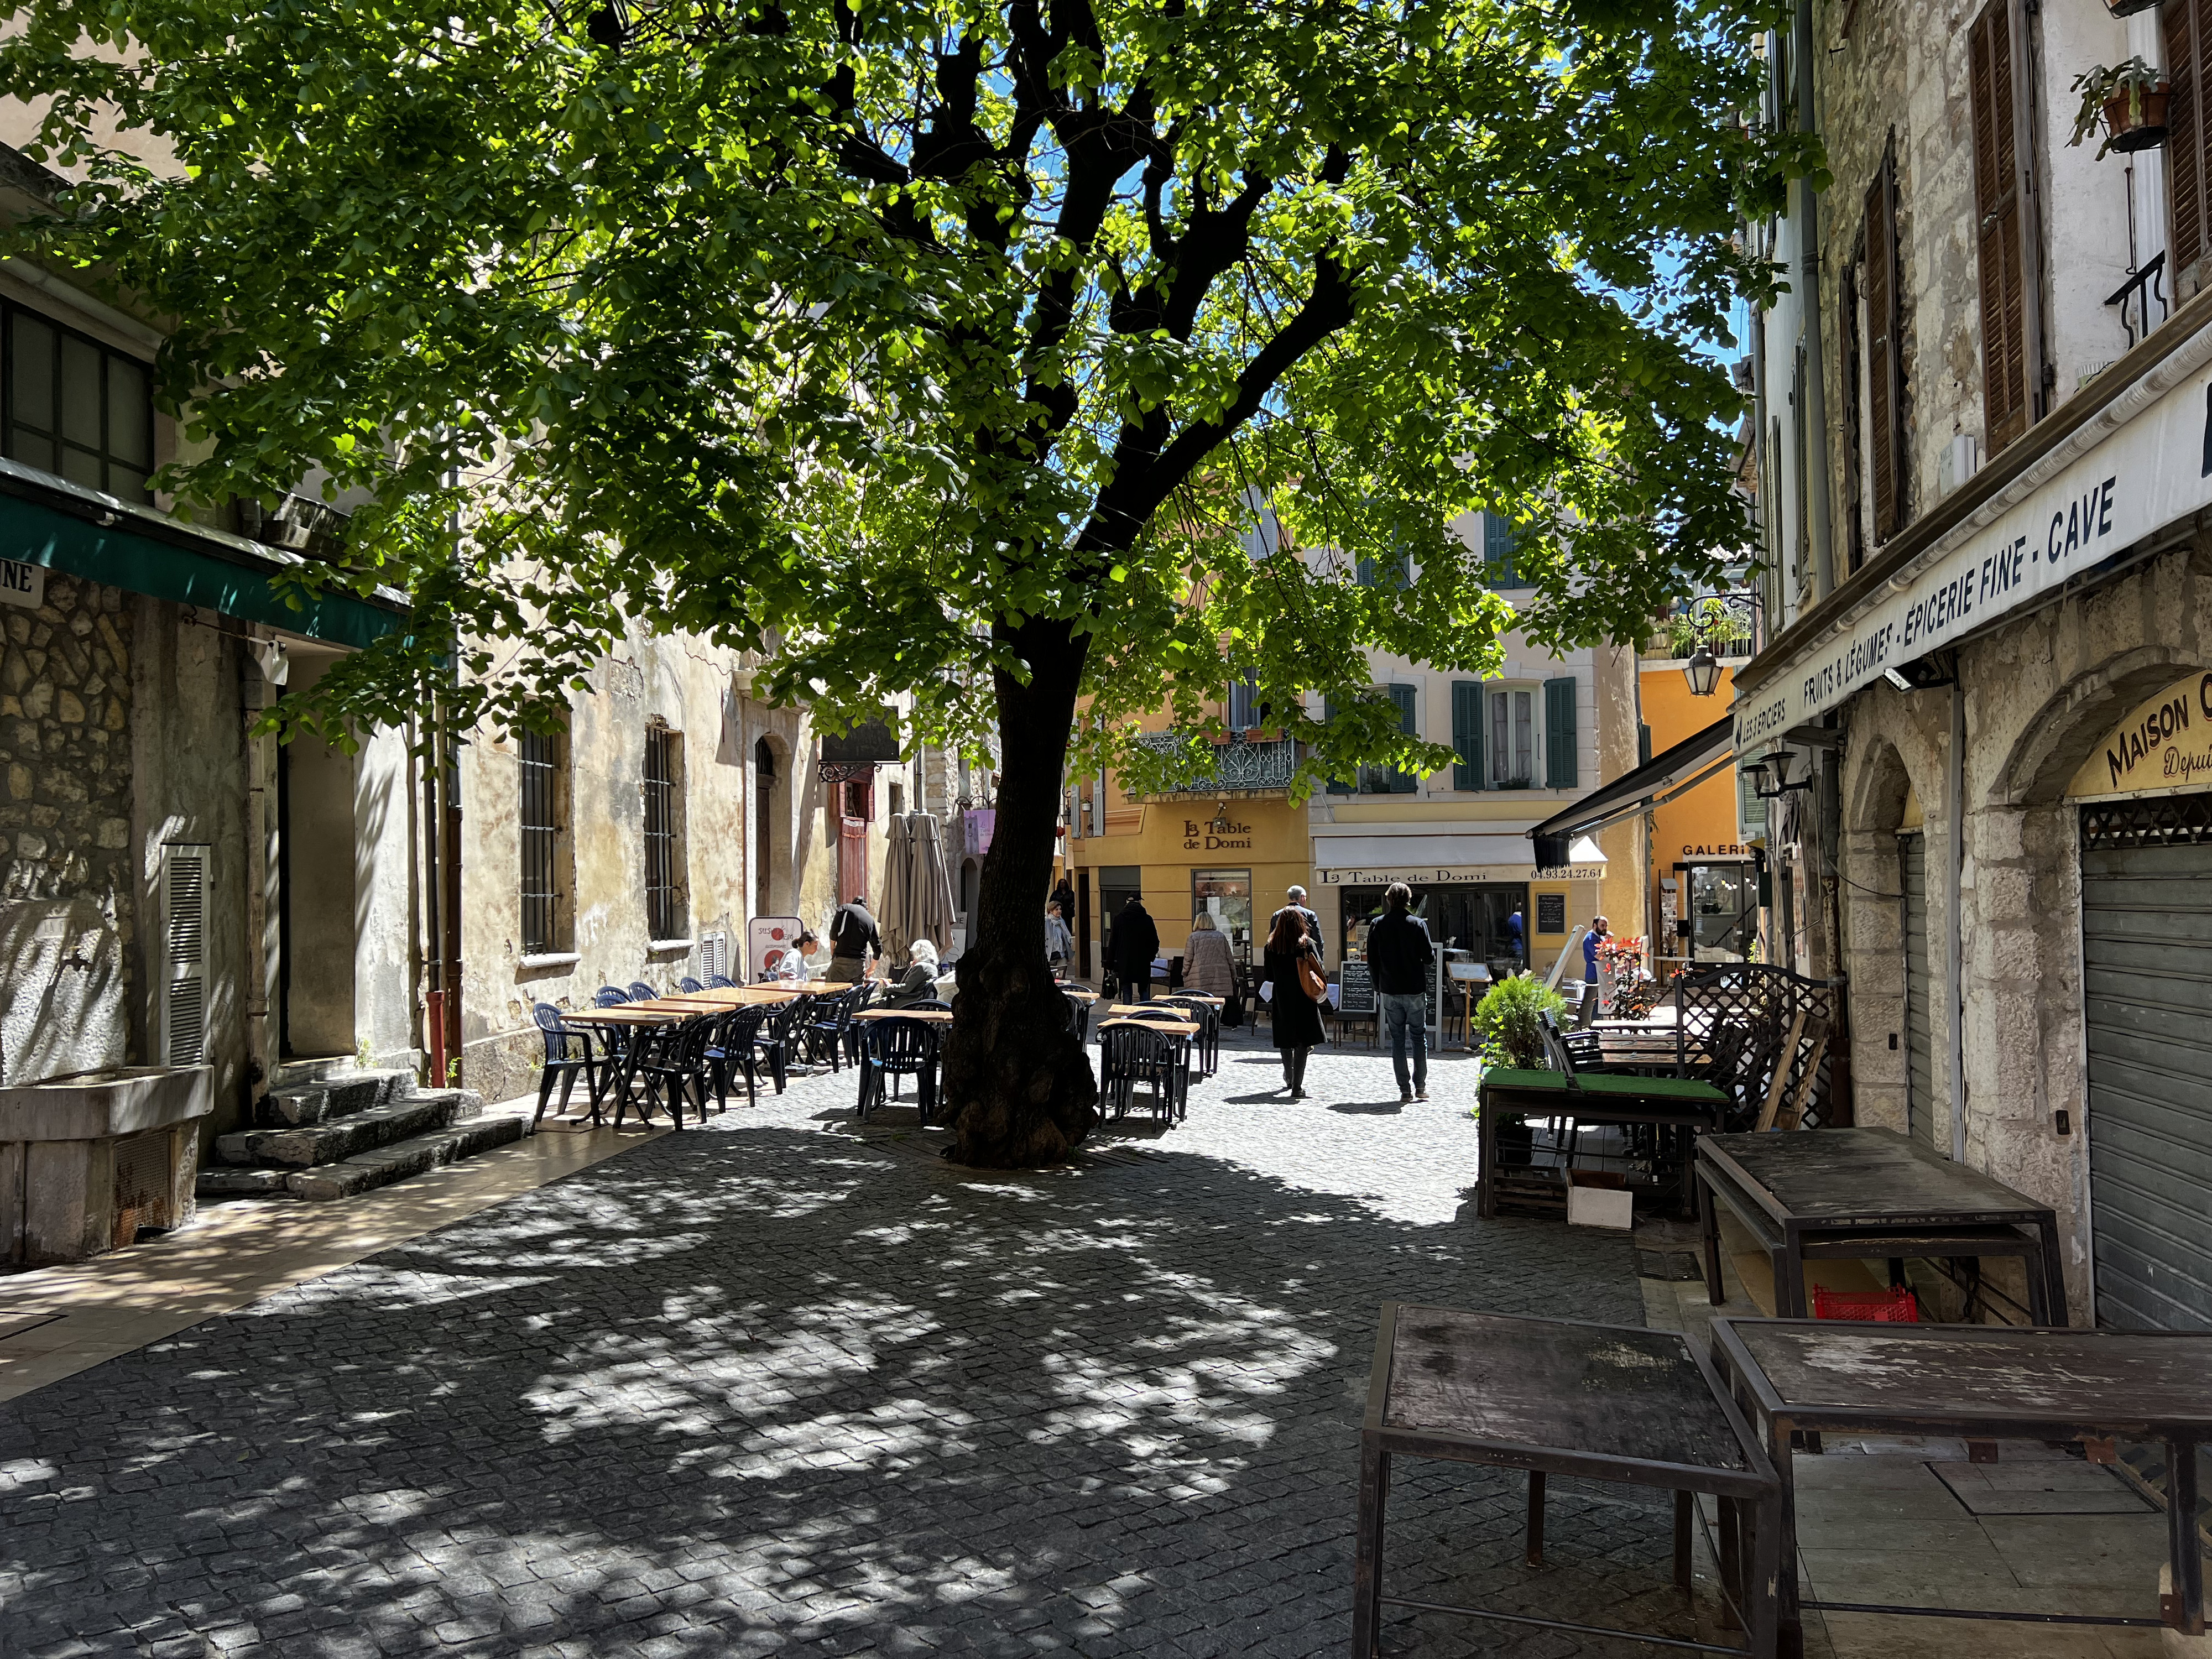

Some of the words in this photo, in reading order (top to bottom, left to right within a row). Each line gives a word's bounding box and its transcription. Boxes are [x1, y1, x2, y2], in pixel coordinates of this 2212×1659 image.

[0, 559, 32, 592] NE
[1743, 718, 1752, 743] LES
[1753, 716, 1757, 737] 3
[1757, 697, 1786, 735] ÉPICIERS
[1804, 664, 1833, 709] FRUITS
[1837, 658, 1841, 688] &
[1845, 623, 1893, 684] LÉGUMES
[1904, 568, 1975, 647] ÉPICERIE
[1980, 535, 2026, 605] FINE
[2048, 475, 2116, 564] CAVE
[2107, 694, 2190, 790] MAISON
[2163, 745, 2212, 783] Depui
[1183, 820, 1200, 837] La
[1204, 821, 1251, 834] Table
[1183, 839, 1200, 849] de
[1204, 836, 1251, 849] Domi
[1683, 845, 1745, 855] GALERi
[1320, 870, 1340, 884] La
[1348, 872, 1400, 883] Table
[1436, 870, 1487, 881] Domi
[1531, 868, 1602, 880] 04.93.24.27.64
